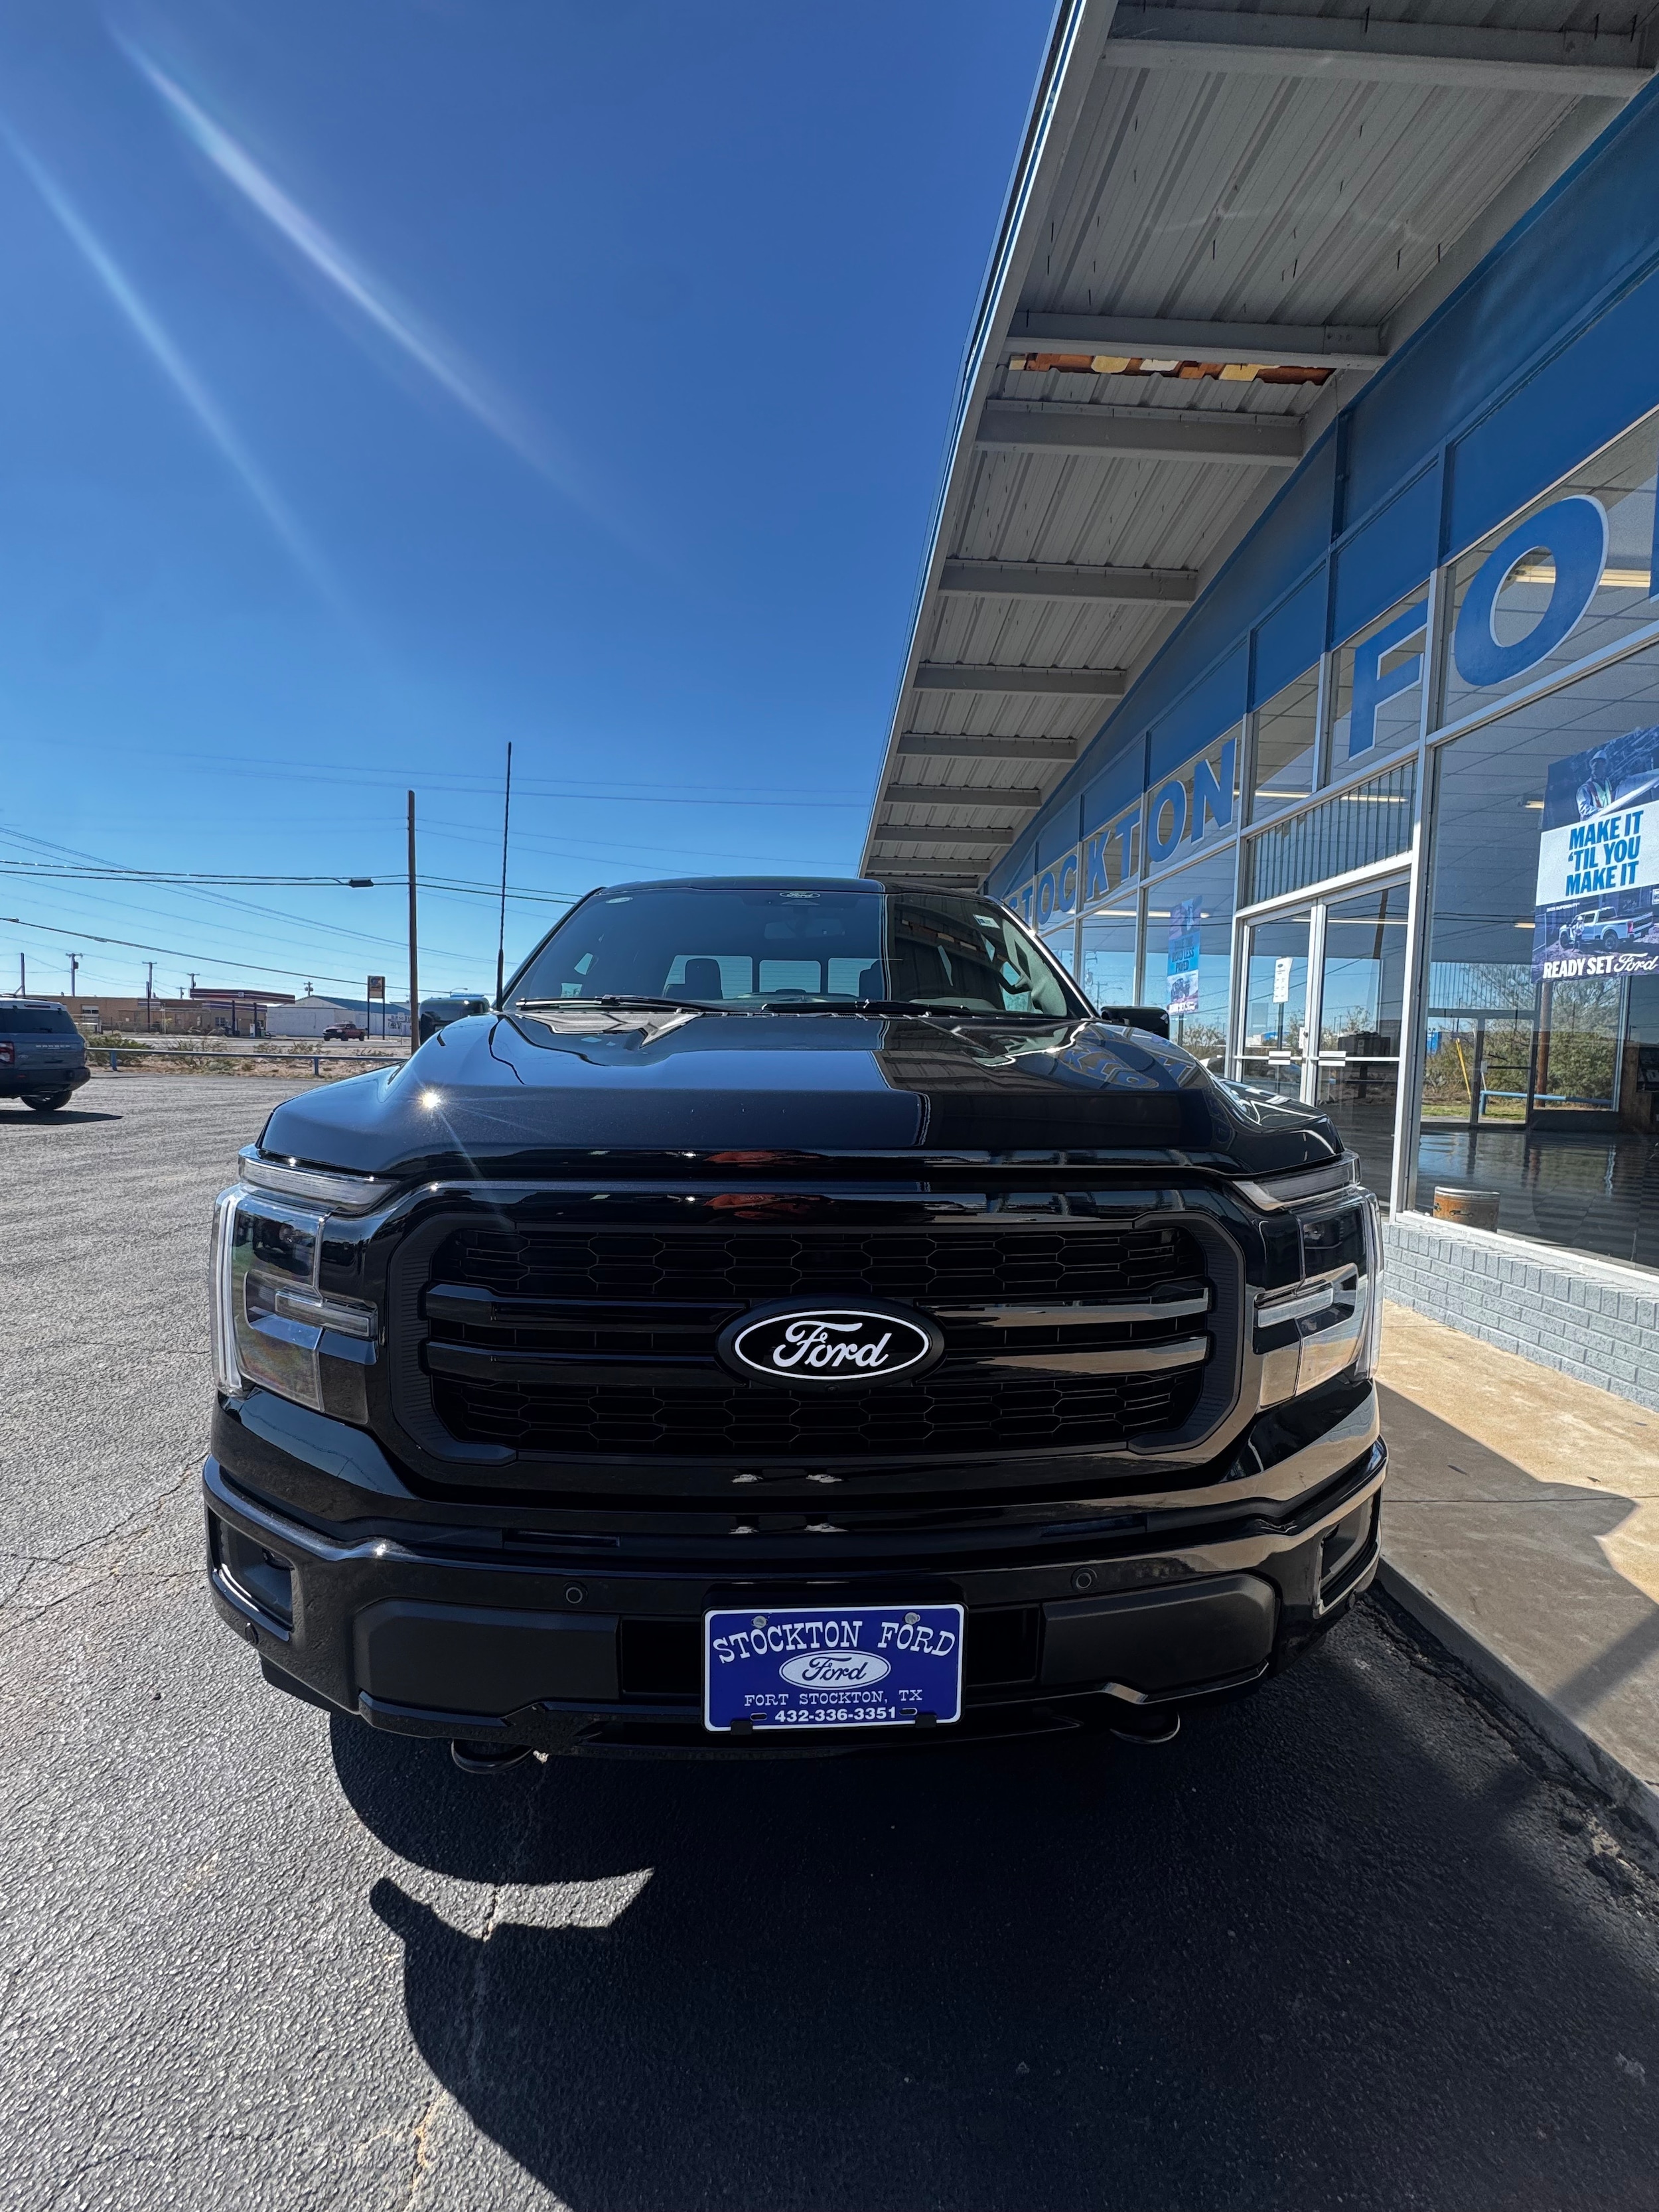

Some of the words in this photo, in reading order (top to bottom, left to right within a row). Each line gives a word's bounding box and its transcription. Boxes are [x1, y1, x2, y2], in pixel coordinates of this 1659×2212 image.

[1569, 816, 1621, 850] MAKE
[1624, 810, 1644, 837] IT
[1603, 836, 1641, 865] YOU
[1565, 865, 1617, 896] MAKE
[1620, 861, 1639, 886] IT
[1543, 958, 1586, 979] READY
[1587, 956, 1615, 975] SET
[1614, 952, 1659, 972] Ford
[772, 1320, 892, 1368] Ford
[713, 1621, 863, 1663] STOCKTON
[877, 1622, 956, 1657] FORD
[802, 1656, 868, 1681] Ford
[745, 1694, 789, 1707] FORT
[799, 1690, 888, 1706] STOCKTON,
[899, 1689, 923, 1702] TX
[775, 1707, 897, 1722] 432-336-3351
